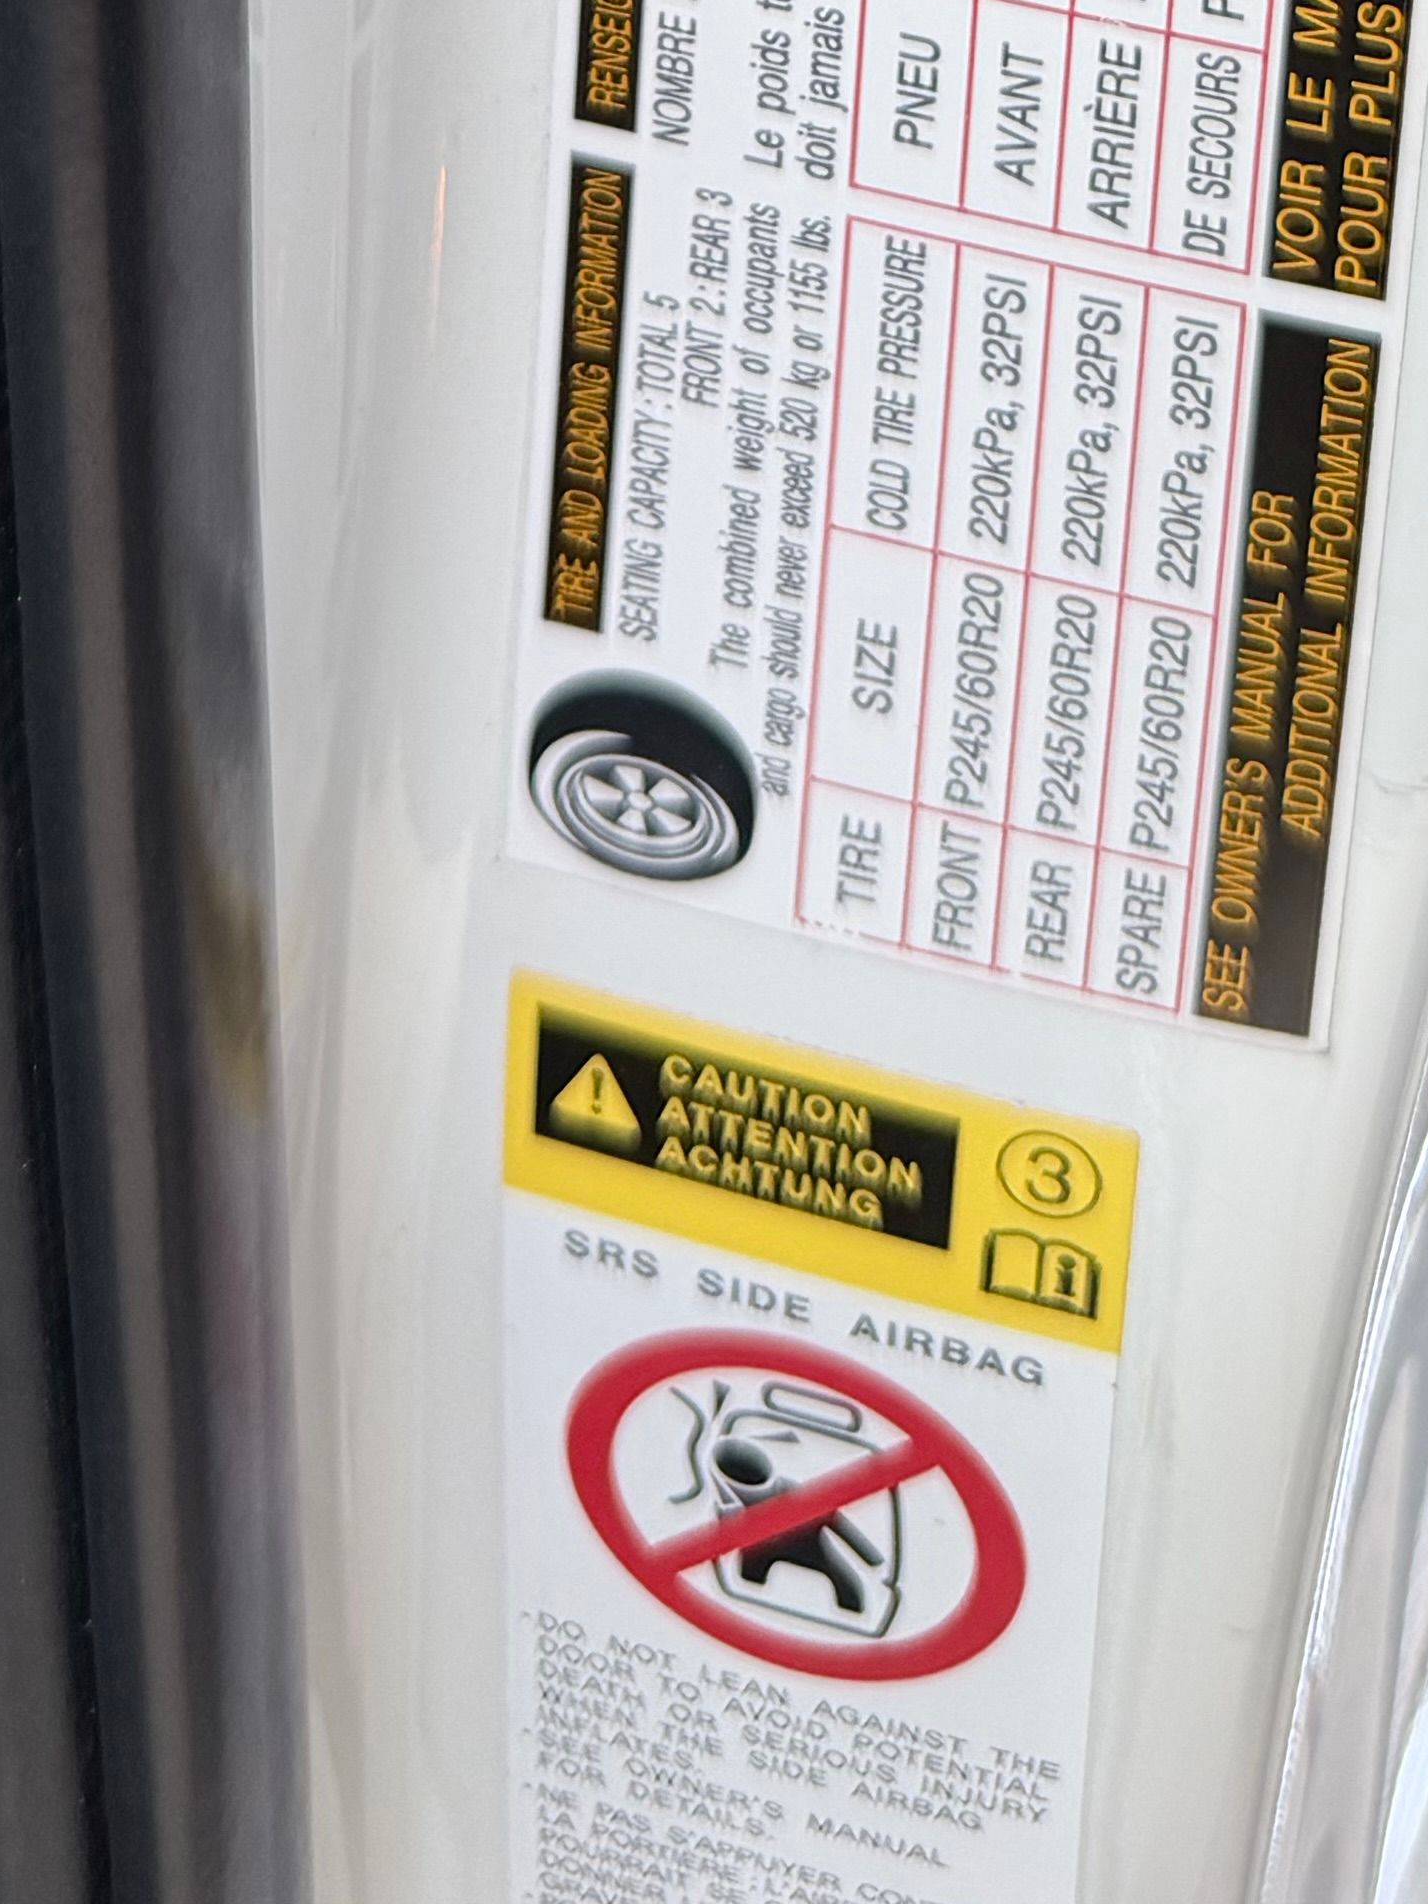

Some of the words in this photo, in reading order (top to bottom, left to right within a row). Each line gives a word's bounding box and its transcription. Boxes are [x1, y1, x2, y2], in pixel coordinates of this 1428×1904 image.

[746, 25, 801, 116] poids
[799, 2, 855, 113] jamais
[892, 31, 942, 150] PNEU
[1284, 70, 1335, 137] LE
[742, 123, 786, 169] Le
[794, 119, 838, 182] doit
[992, 41, 1045, 186] AVANT
[573, 166, 623, 352] INFORMATION
[1271, 156, 1327, 276] VOIR
[1332, 148, 1391, 288] POUR
[737, 199, 788, 336] occupants
[875, 232, 929, 379] PRESSURE
[730, 345, 770, 375] of
[977, 271, 1029, 389] 32PSI
[565, 358, 612, 480] LOADING
[721, 385, 775, 474] weight
[870, 384, 917, 448] TIRE
[561, 486, 603, 545] AND
[863, 455, 912, 533] COLD
[1302, 337, 1373, 603] INFORMATION
[712, 484, 761, 609] combined
[1246, 486, 1295, 571] FOR
[556, 553, 598, 622] TIRE
[708, 618, 751, 672] The
[851, 615, 899, 716] SIZE
[944, 568, 1004, 809] P245/60R20
[1229, 584, 1286, 740] MANUAL
[1279, 613, 1345, 836] ADDITIONAL
[836, 813, 883, 910] TIRE
[931, 819, 983, 953] FRONT
[1210, 753, 1269, 927] OWNER'S
[1201, 938, 1250, 1014] SEE
[656, 1096, 922, 1194] ATTENTION
[659, 1055, 870, 1137] CAUTION
[655, 1139, 885, 1232] ACHTUNG
[1025, 1147, 1073, 1205] 3
[565, 1229, 660, 1279] SRS
[698, 1267, 811, 1324] SIDE
[850, 1314, 1046, 1387] AIRBAG
